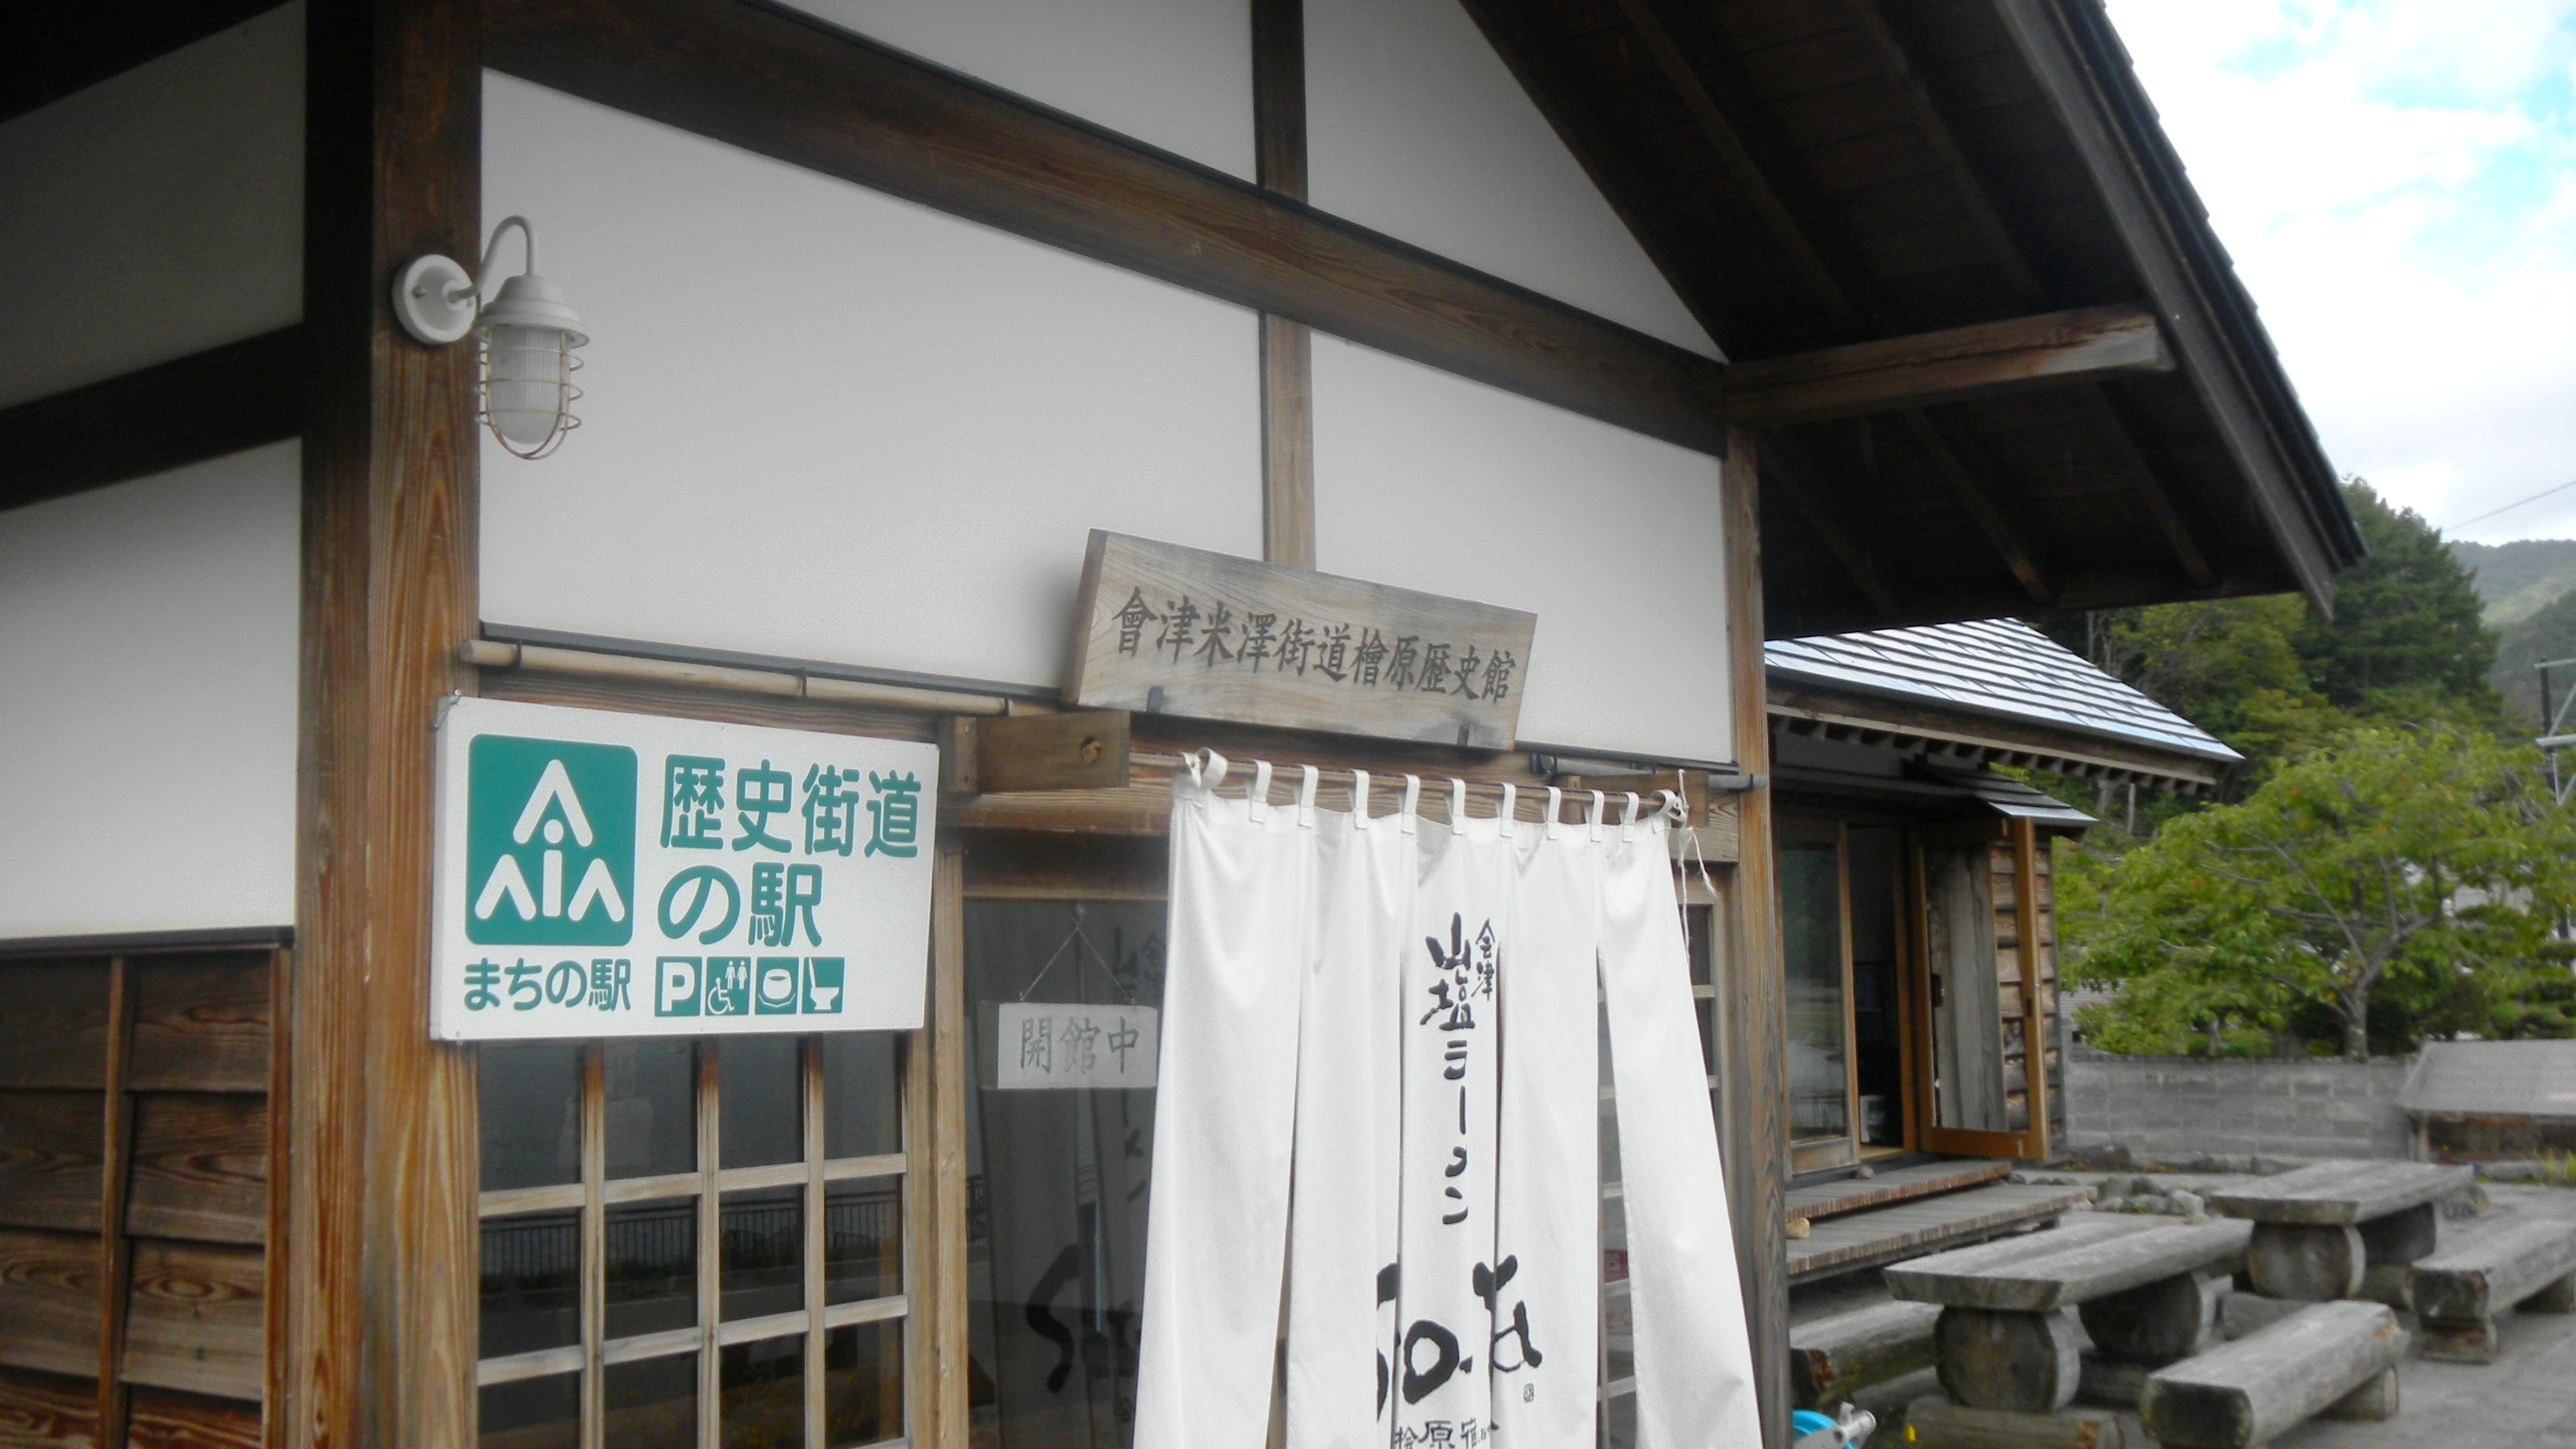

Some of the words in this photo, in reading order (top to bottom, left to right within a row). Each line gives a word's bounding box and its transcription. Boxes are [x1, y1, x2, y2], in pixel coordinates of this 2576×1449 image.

[660, 753, 921, 858] 歴史街道
[657, 861, 823, 947] の駅
[464, 956, 632, 1011] まちの駅
[662, 961, 696, 1012] P
[1475, 918, 1495, 1001] 会津
[1020, 1015, 1140, 1074] 開館中
